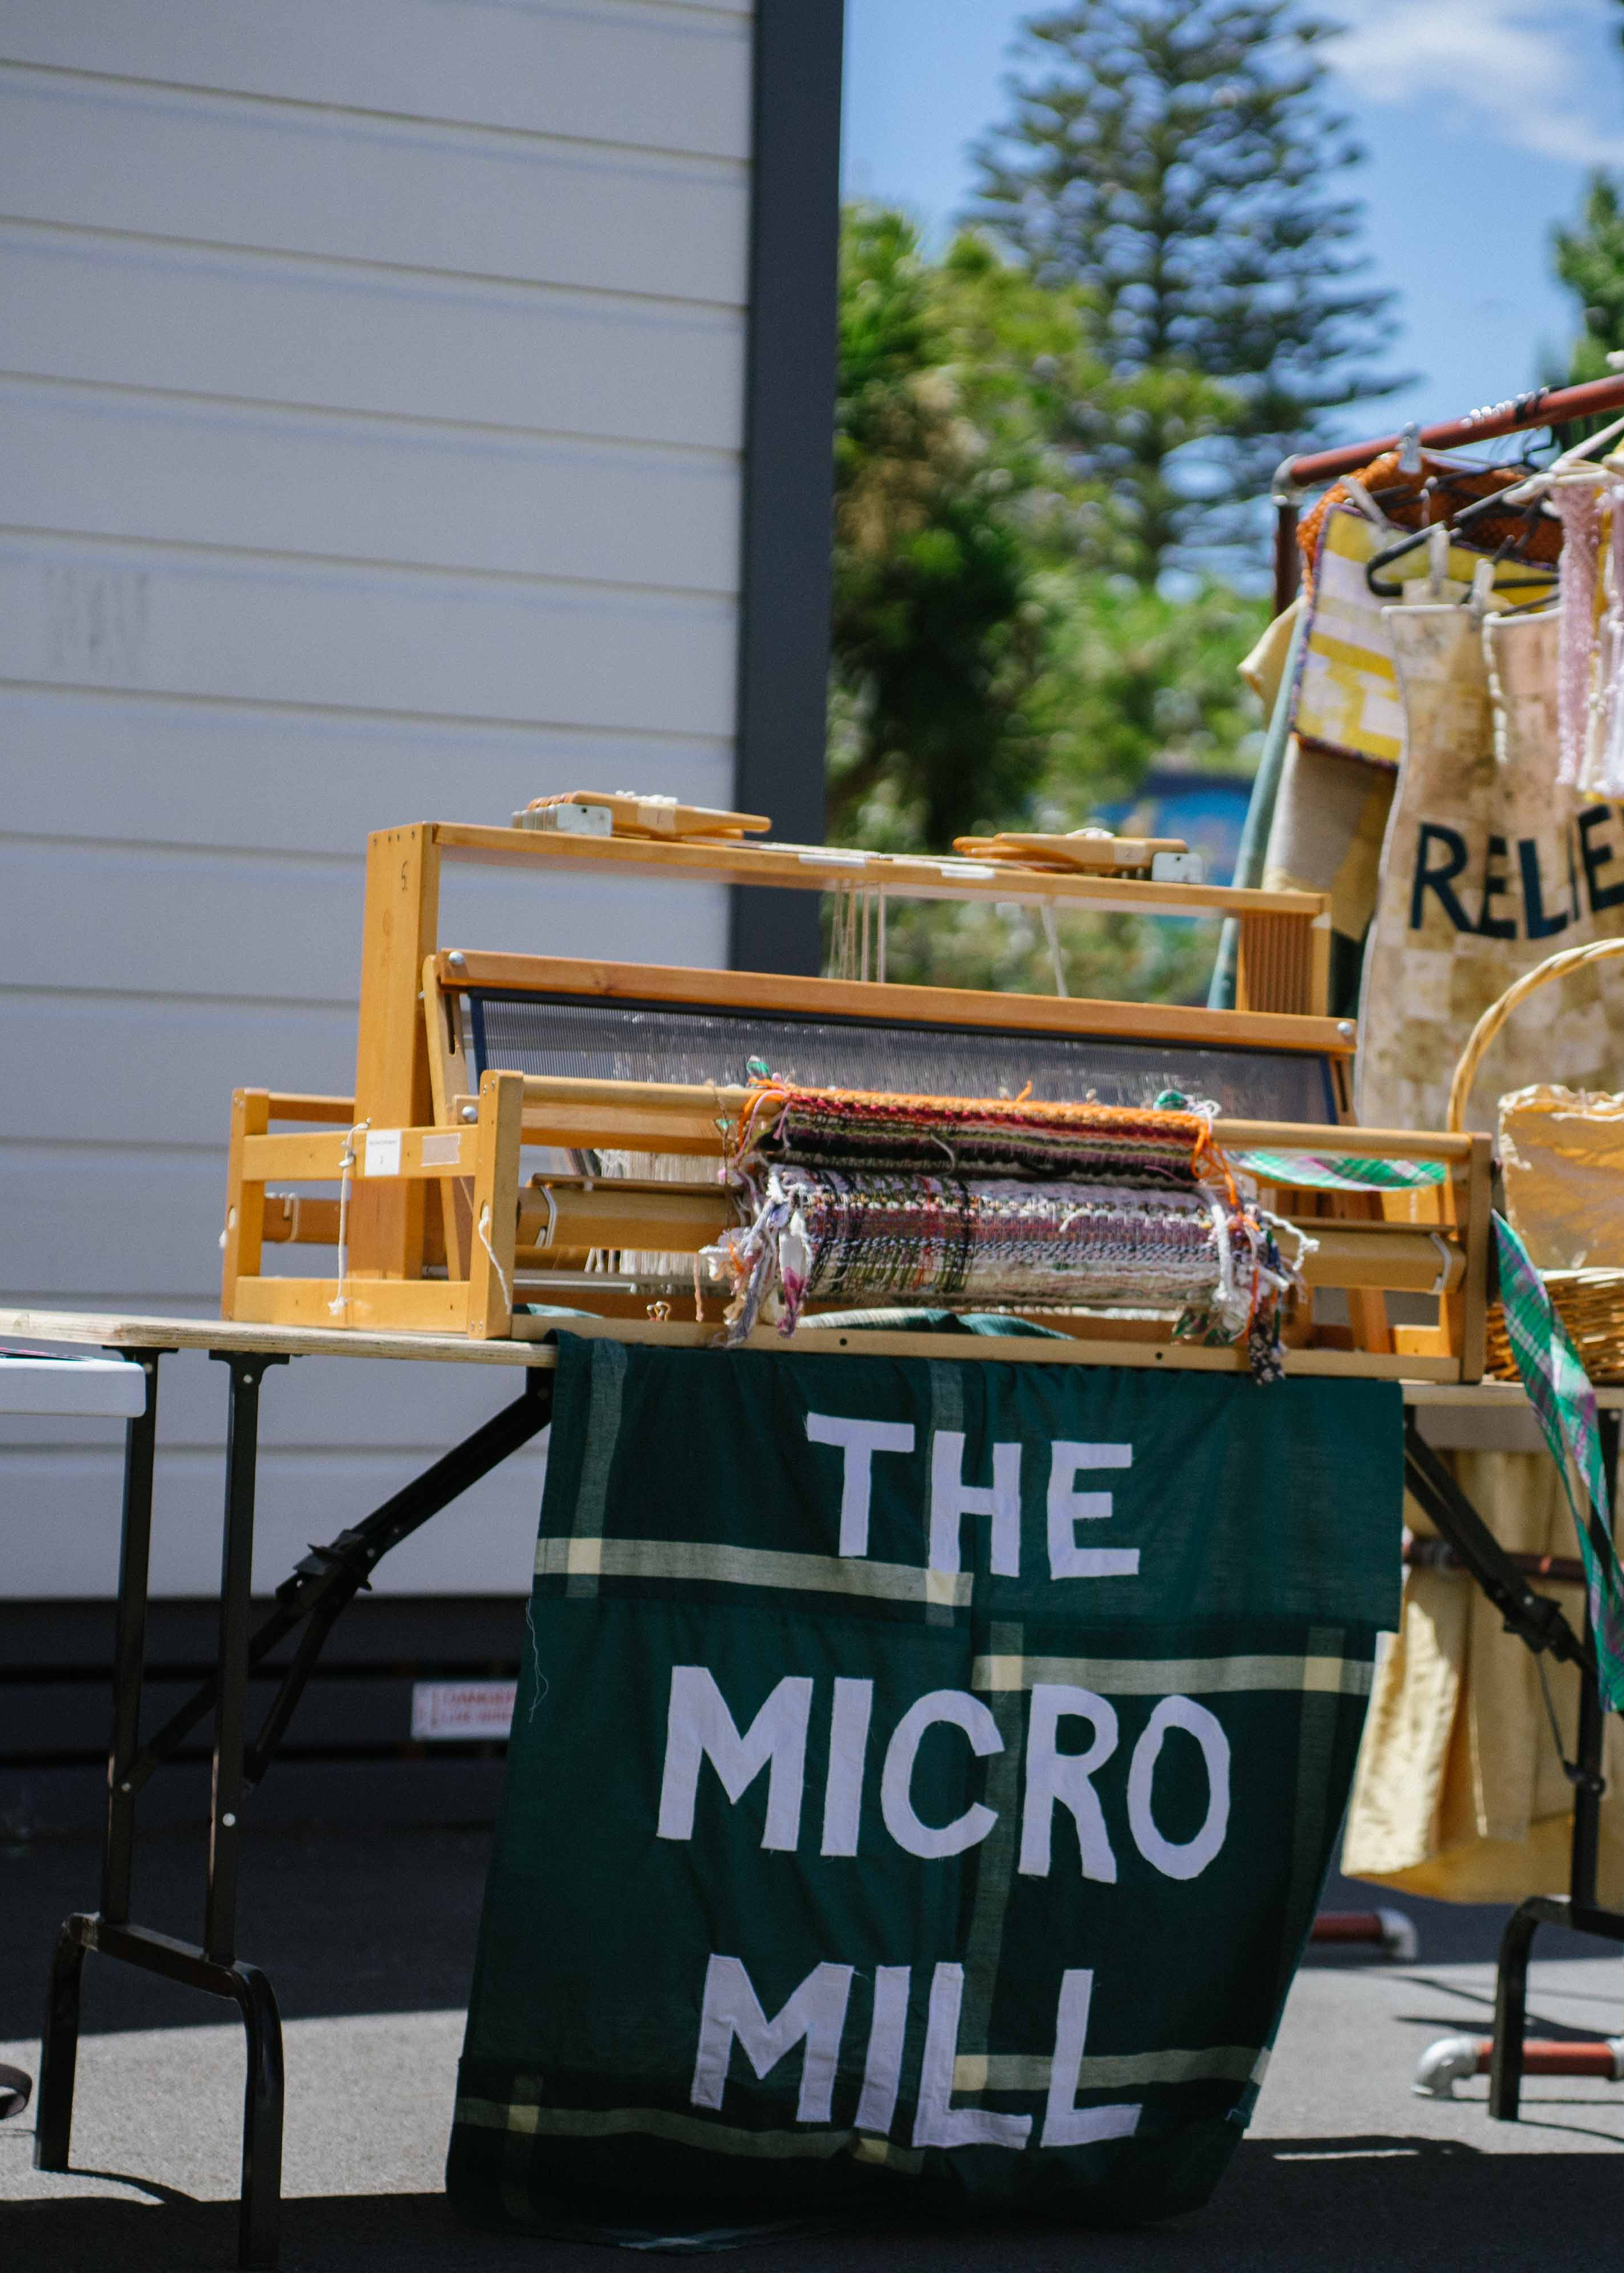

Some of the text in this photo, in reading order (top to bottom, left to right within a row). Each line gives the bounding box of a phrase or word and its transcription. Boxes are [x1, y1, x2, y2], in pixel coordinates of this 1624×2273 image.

[1410, 805, 1624, 940] RELIE
[804, 1411, 1140, 1580] THE
[657, 1665, 1231, 1884] MICRO
[691, 1953, 1143, 2150] MILL
